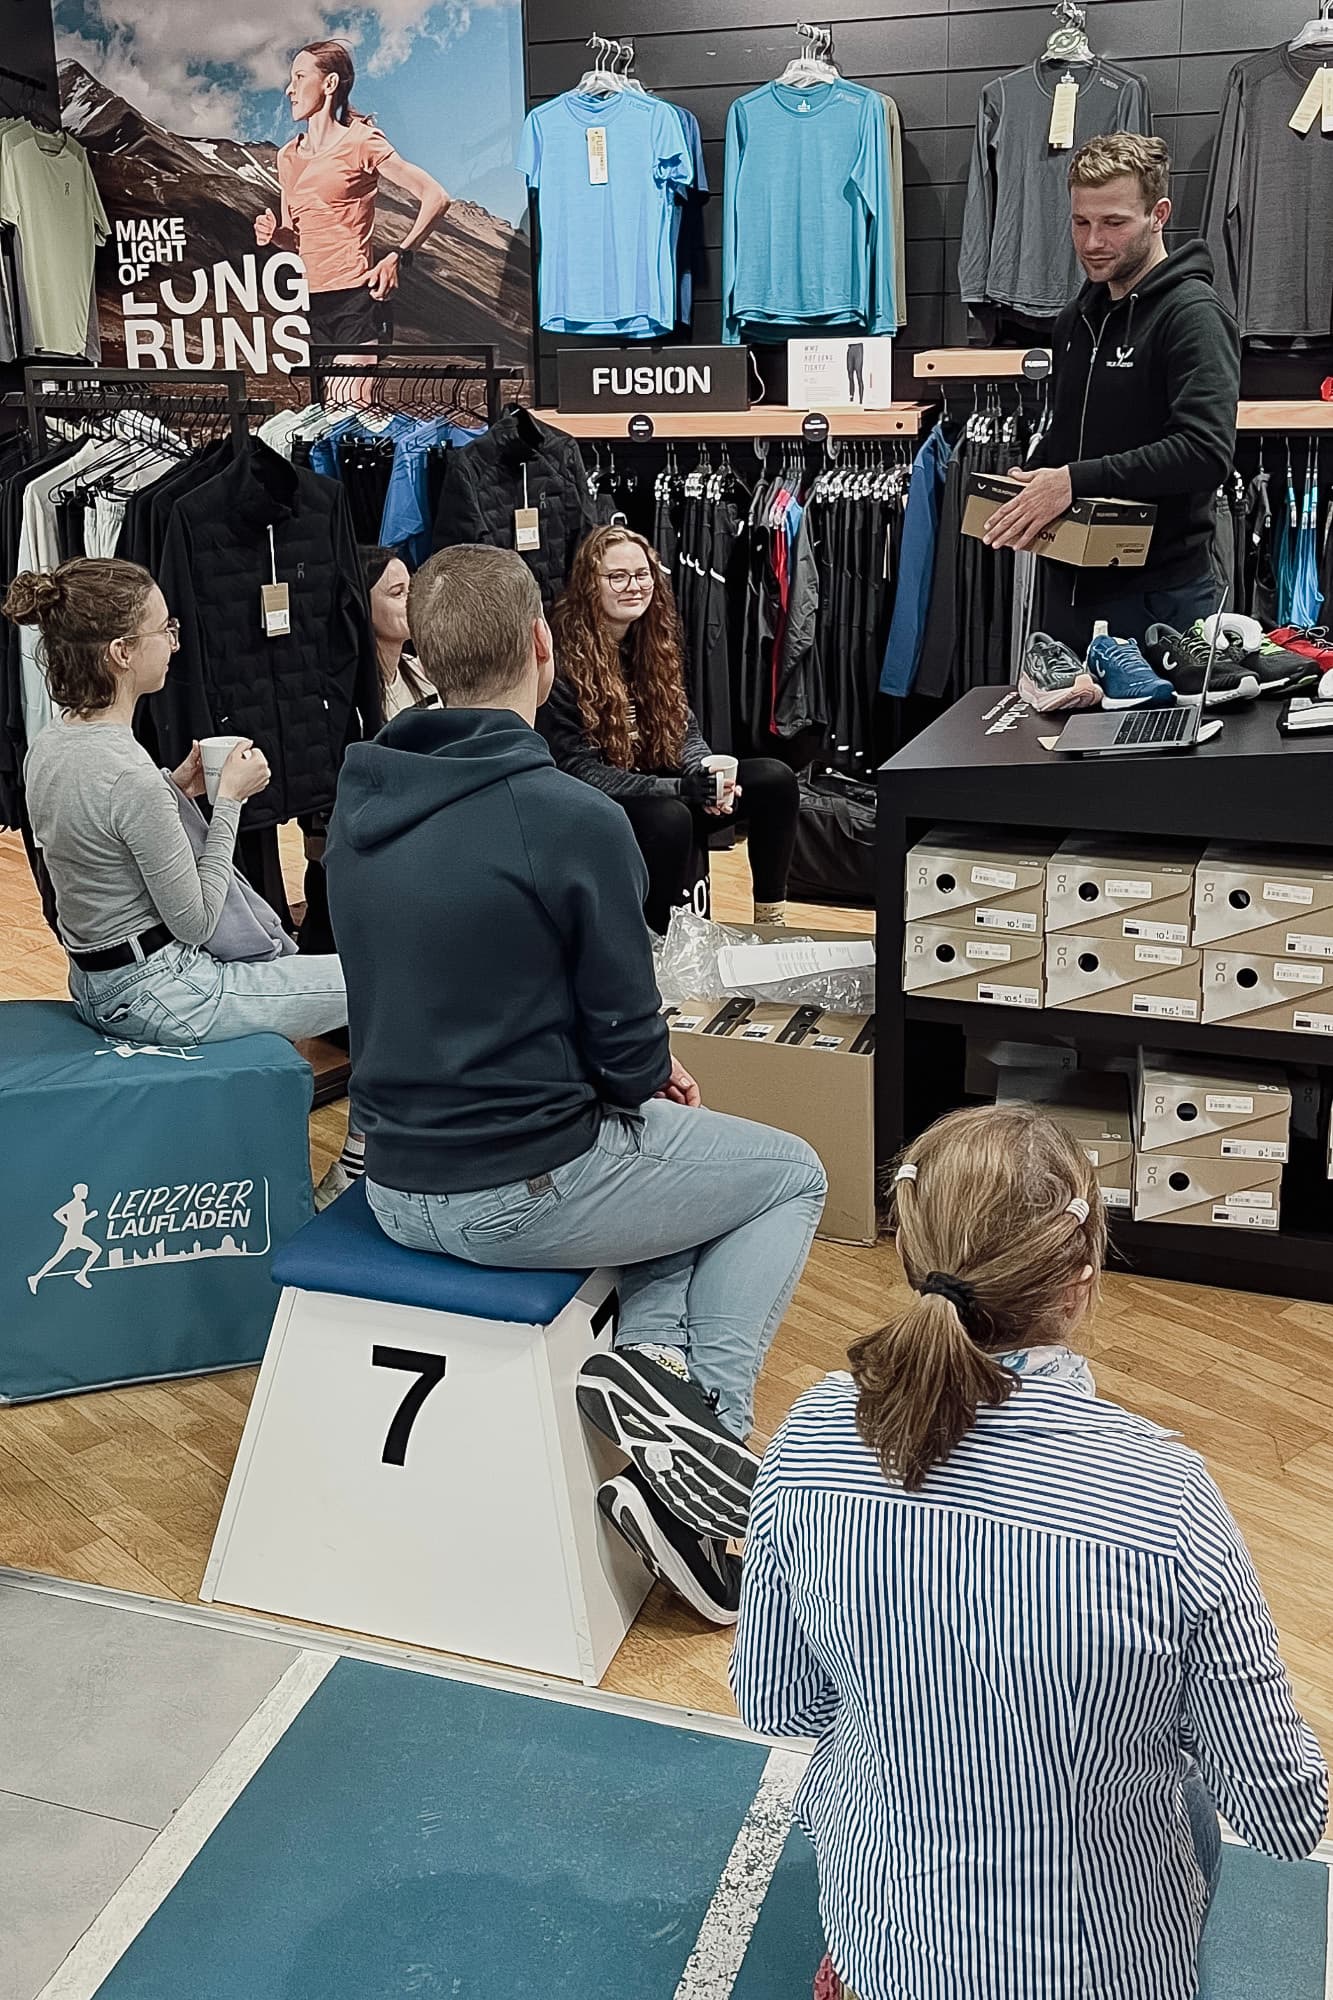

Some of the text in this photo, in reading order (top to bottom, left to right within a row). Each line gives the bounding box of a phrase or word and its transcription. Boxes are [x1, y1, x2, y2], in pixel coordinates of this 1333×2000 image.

[116, 218, 185, 242] MAKE
[118, 240, 187, 263] LIGHT
[118, 264, 150, 286] OF
[122, 252, 310, 315] LONG
[124, 314, 311, 374] RUNS
[592, 366, 711, 395] FUSION
[1006, 920, 1015, 928] 10
[106, 1179, 254, 1220] LEIPZIGER
[106, 1208, 251, 1240] LAUFLADEN
[371, 1344, 447, 1467] 7
